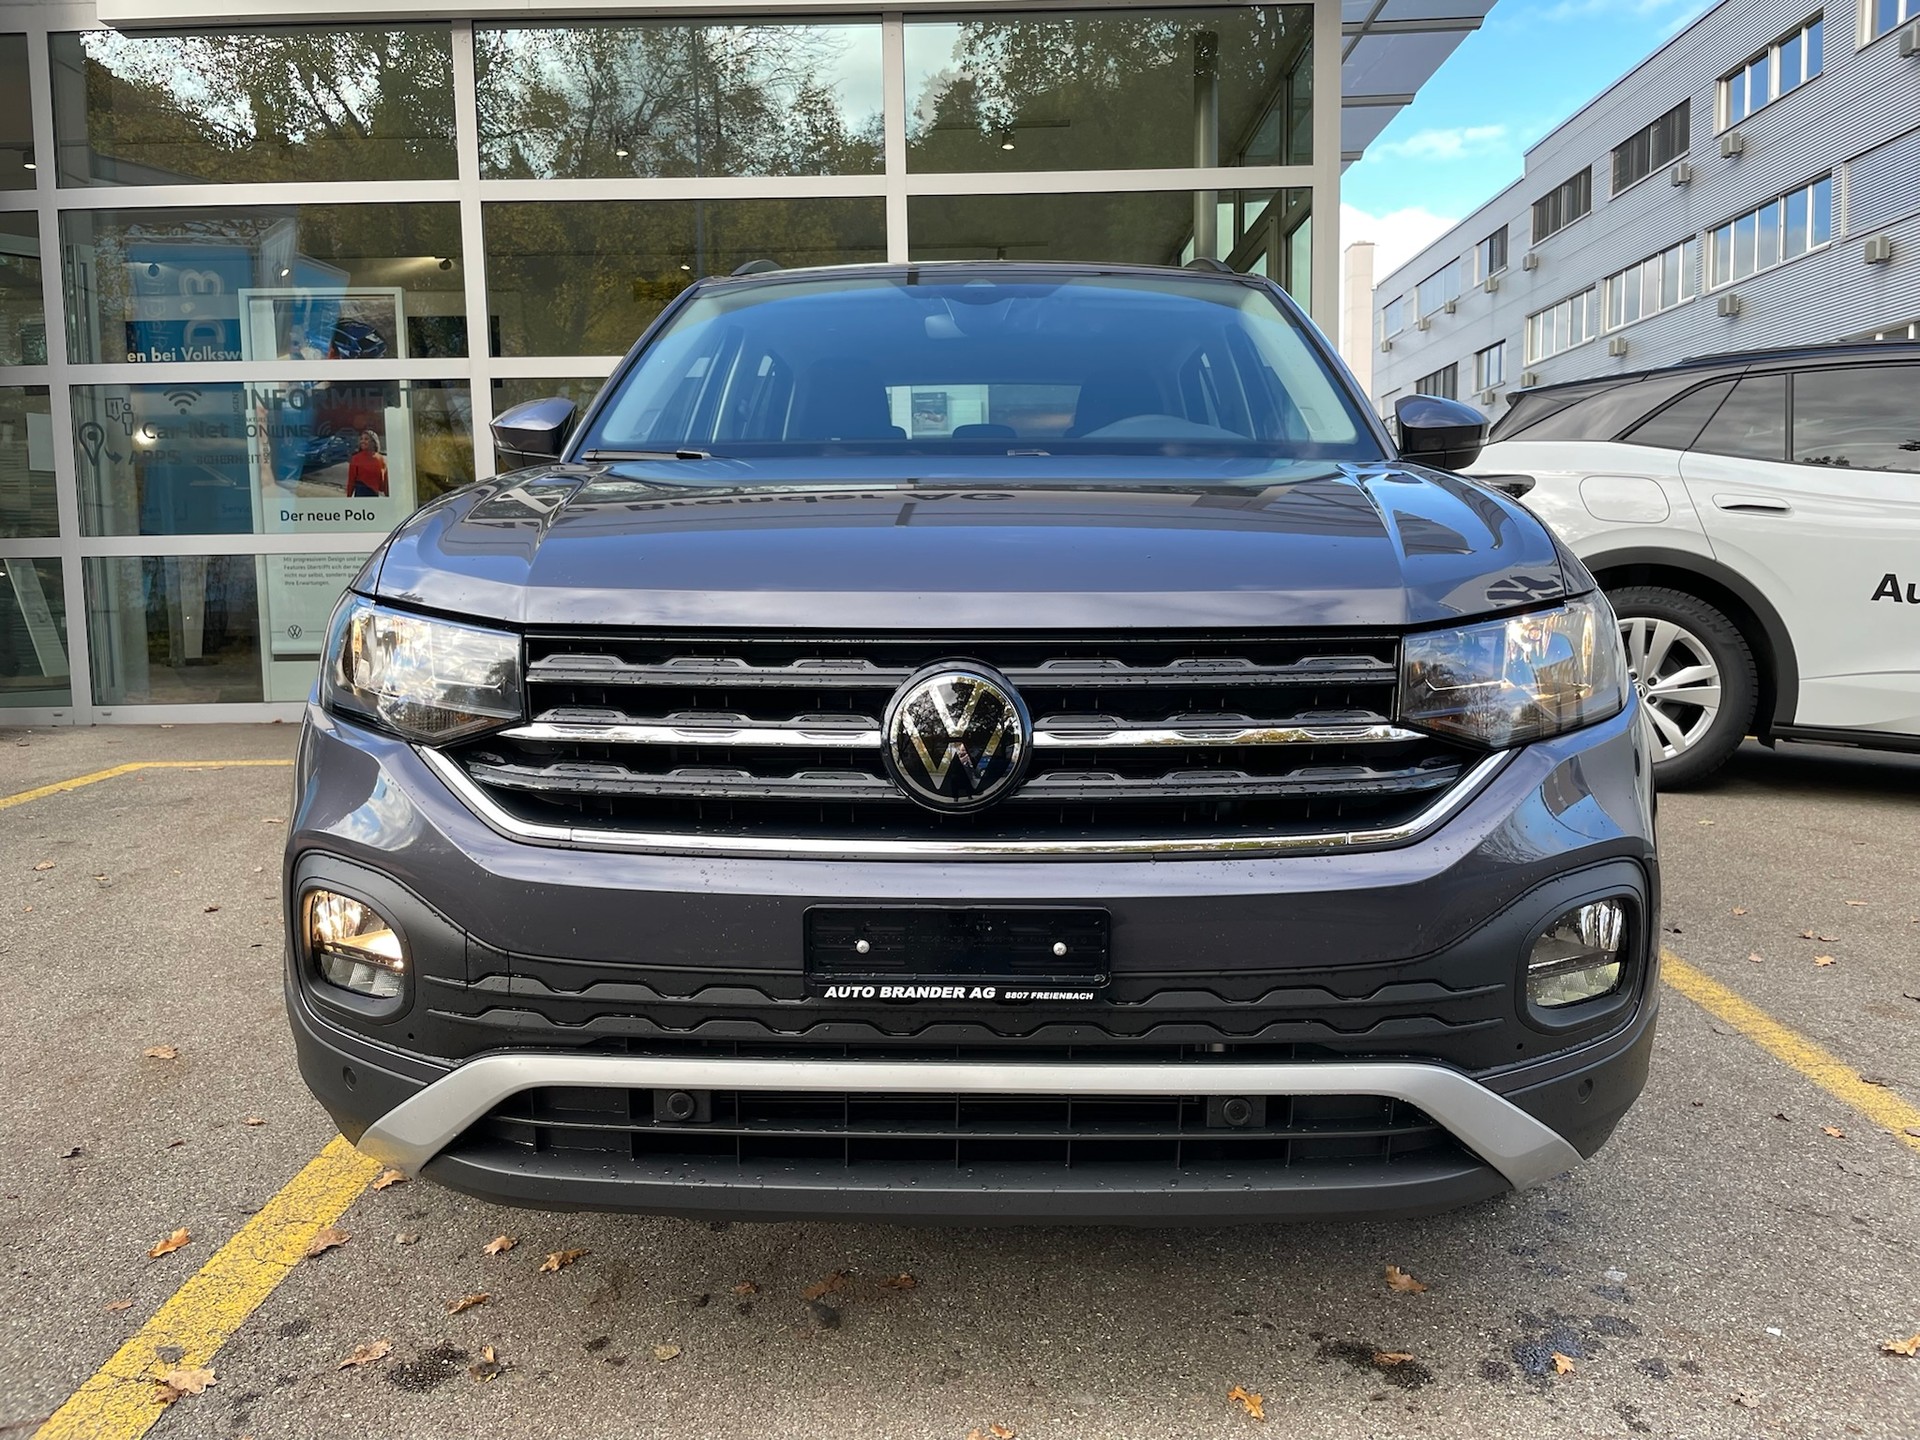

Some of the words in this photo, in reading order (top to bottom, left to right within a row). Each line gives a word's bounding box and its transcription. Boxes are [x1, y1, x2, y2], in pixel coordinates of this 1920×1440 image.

[127, 352, 146, 362] en
[151, 347, 176, 362] bei
[128, 451, 183, 465] APPS
[280, 510, 304, 521] Der
[307, 512, 340, 521] neue
[345, 509, 375, 521] Polo
[889, 671, 1023, 803] VW
[824, 986, 875, 998] AUTO
[879, 986, 966, 999] BRANDER
[969, 987, 996, 999] AG
[1004, 991, 1029, 999] 8807
[1030, 991, 1094, 1000] FREIENBACH
